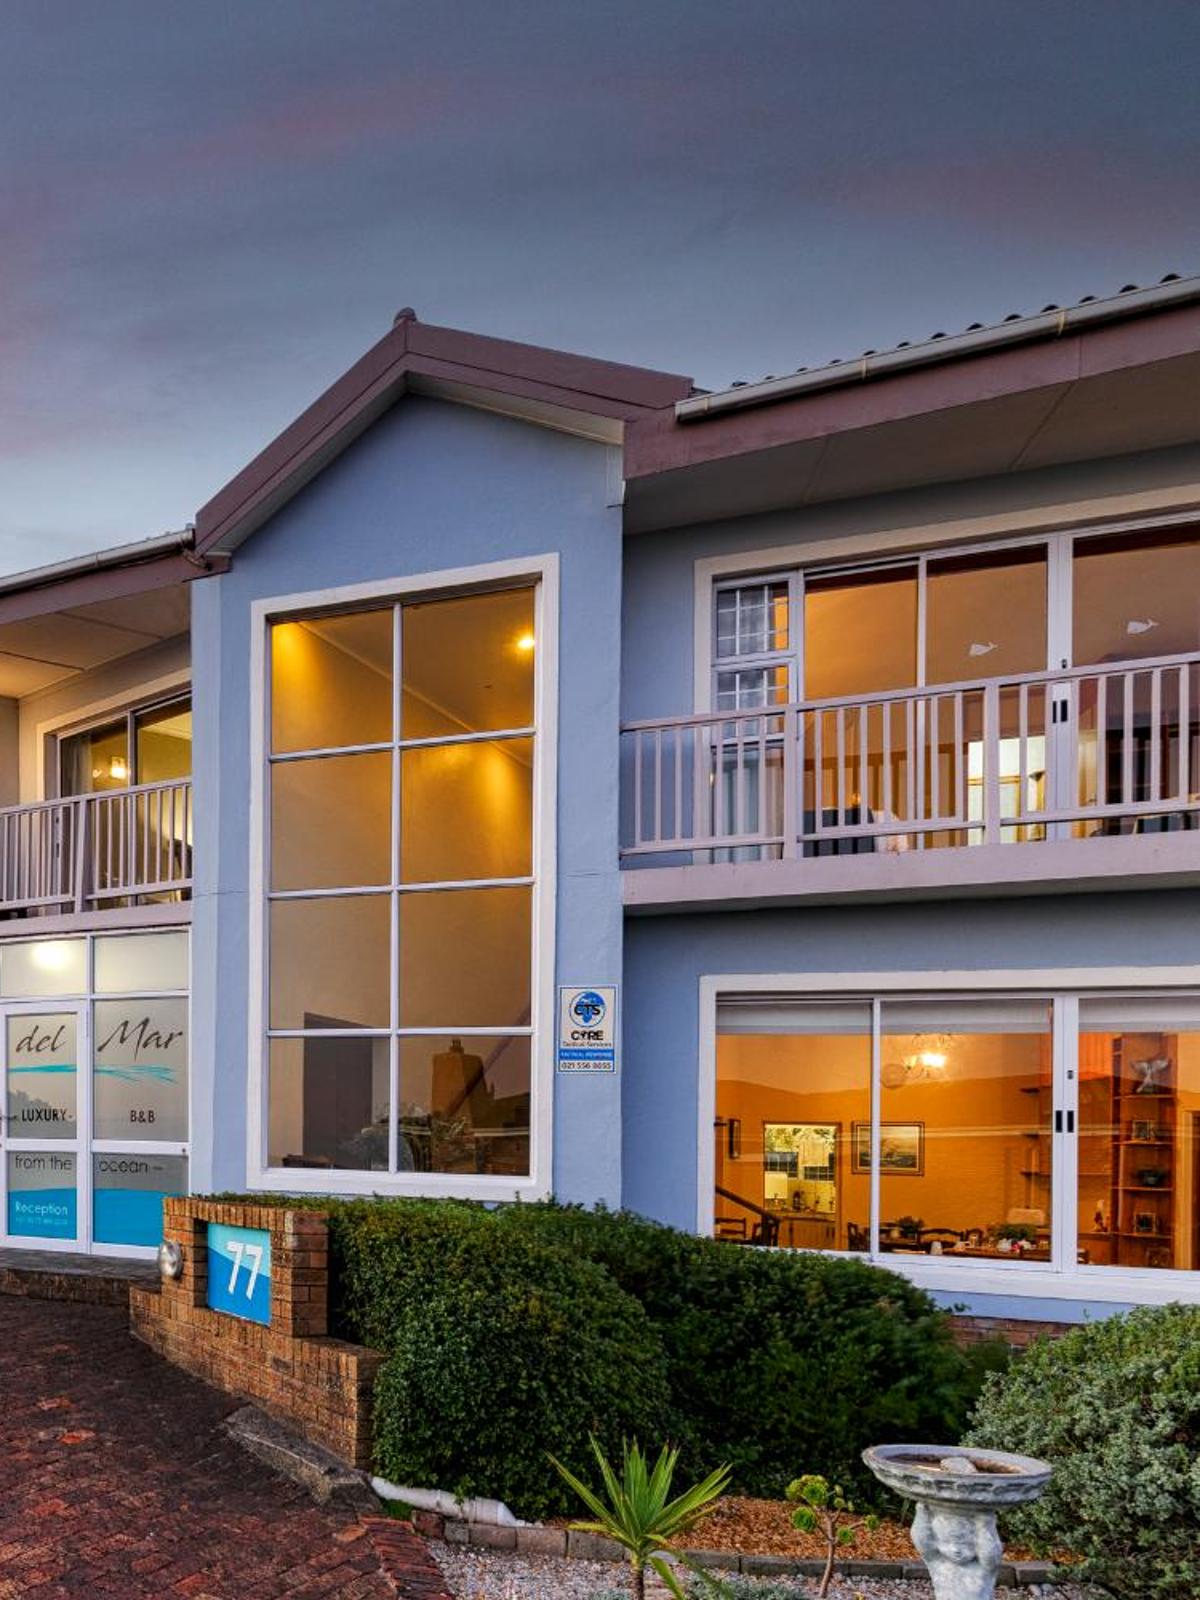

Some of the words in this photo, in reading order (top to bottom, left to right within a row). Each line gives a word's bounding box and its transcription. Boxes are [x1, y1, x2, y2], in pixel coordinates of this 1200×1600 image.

[574, 1005, 601, 1015] CTS
[15, 1025, 67, 1053] del
[96, 1017, 183, 1061] Mar
[22, 1109, 68, 1122] LUXURY
[130, 1109, 155, 1124] B&B
[15, 1154, 46, 1170] from
[50, 1155, 73, 1171] the
[100, 1160, 148, 1174] ocean
[15, 1200, 68, 1216] Reception
[226, 1240, 264, 1301] 77
